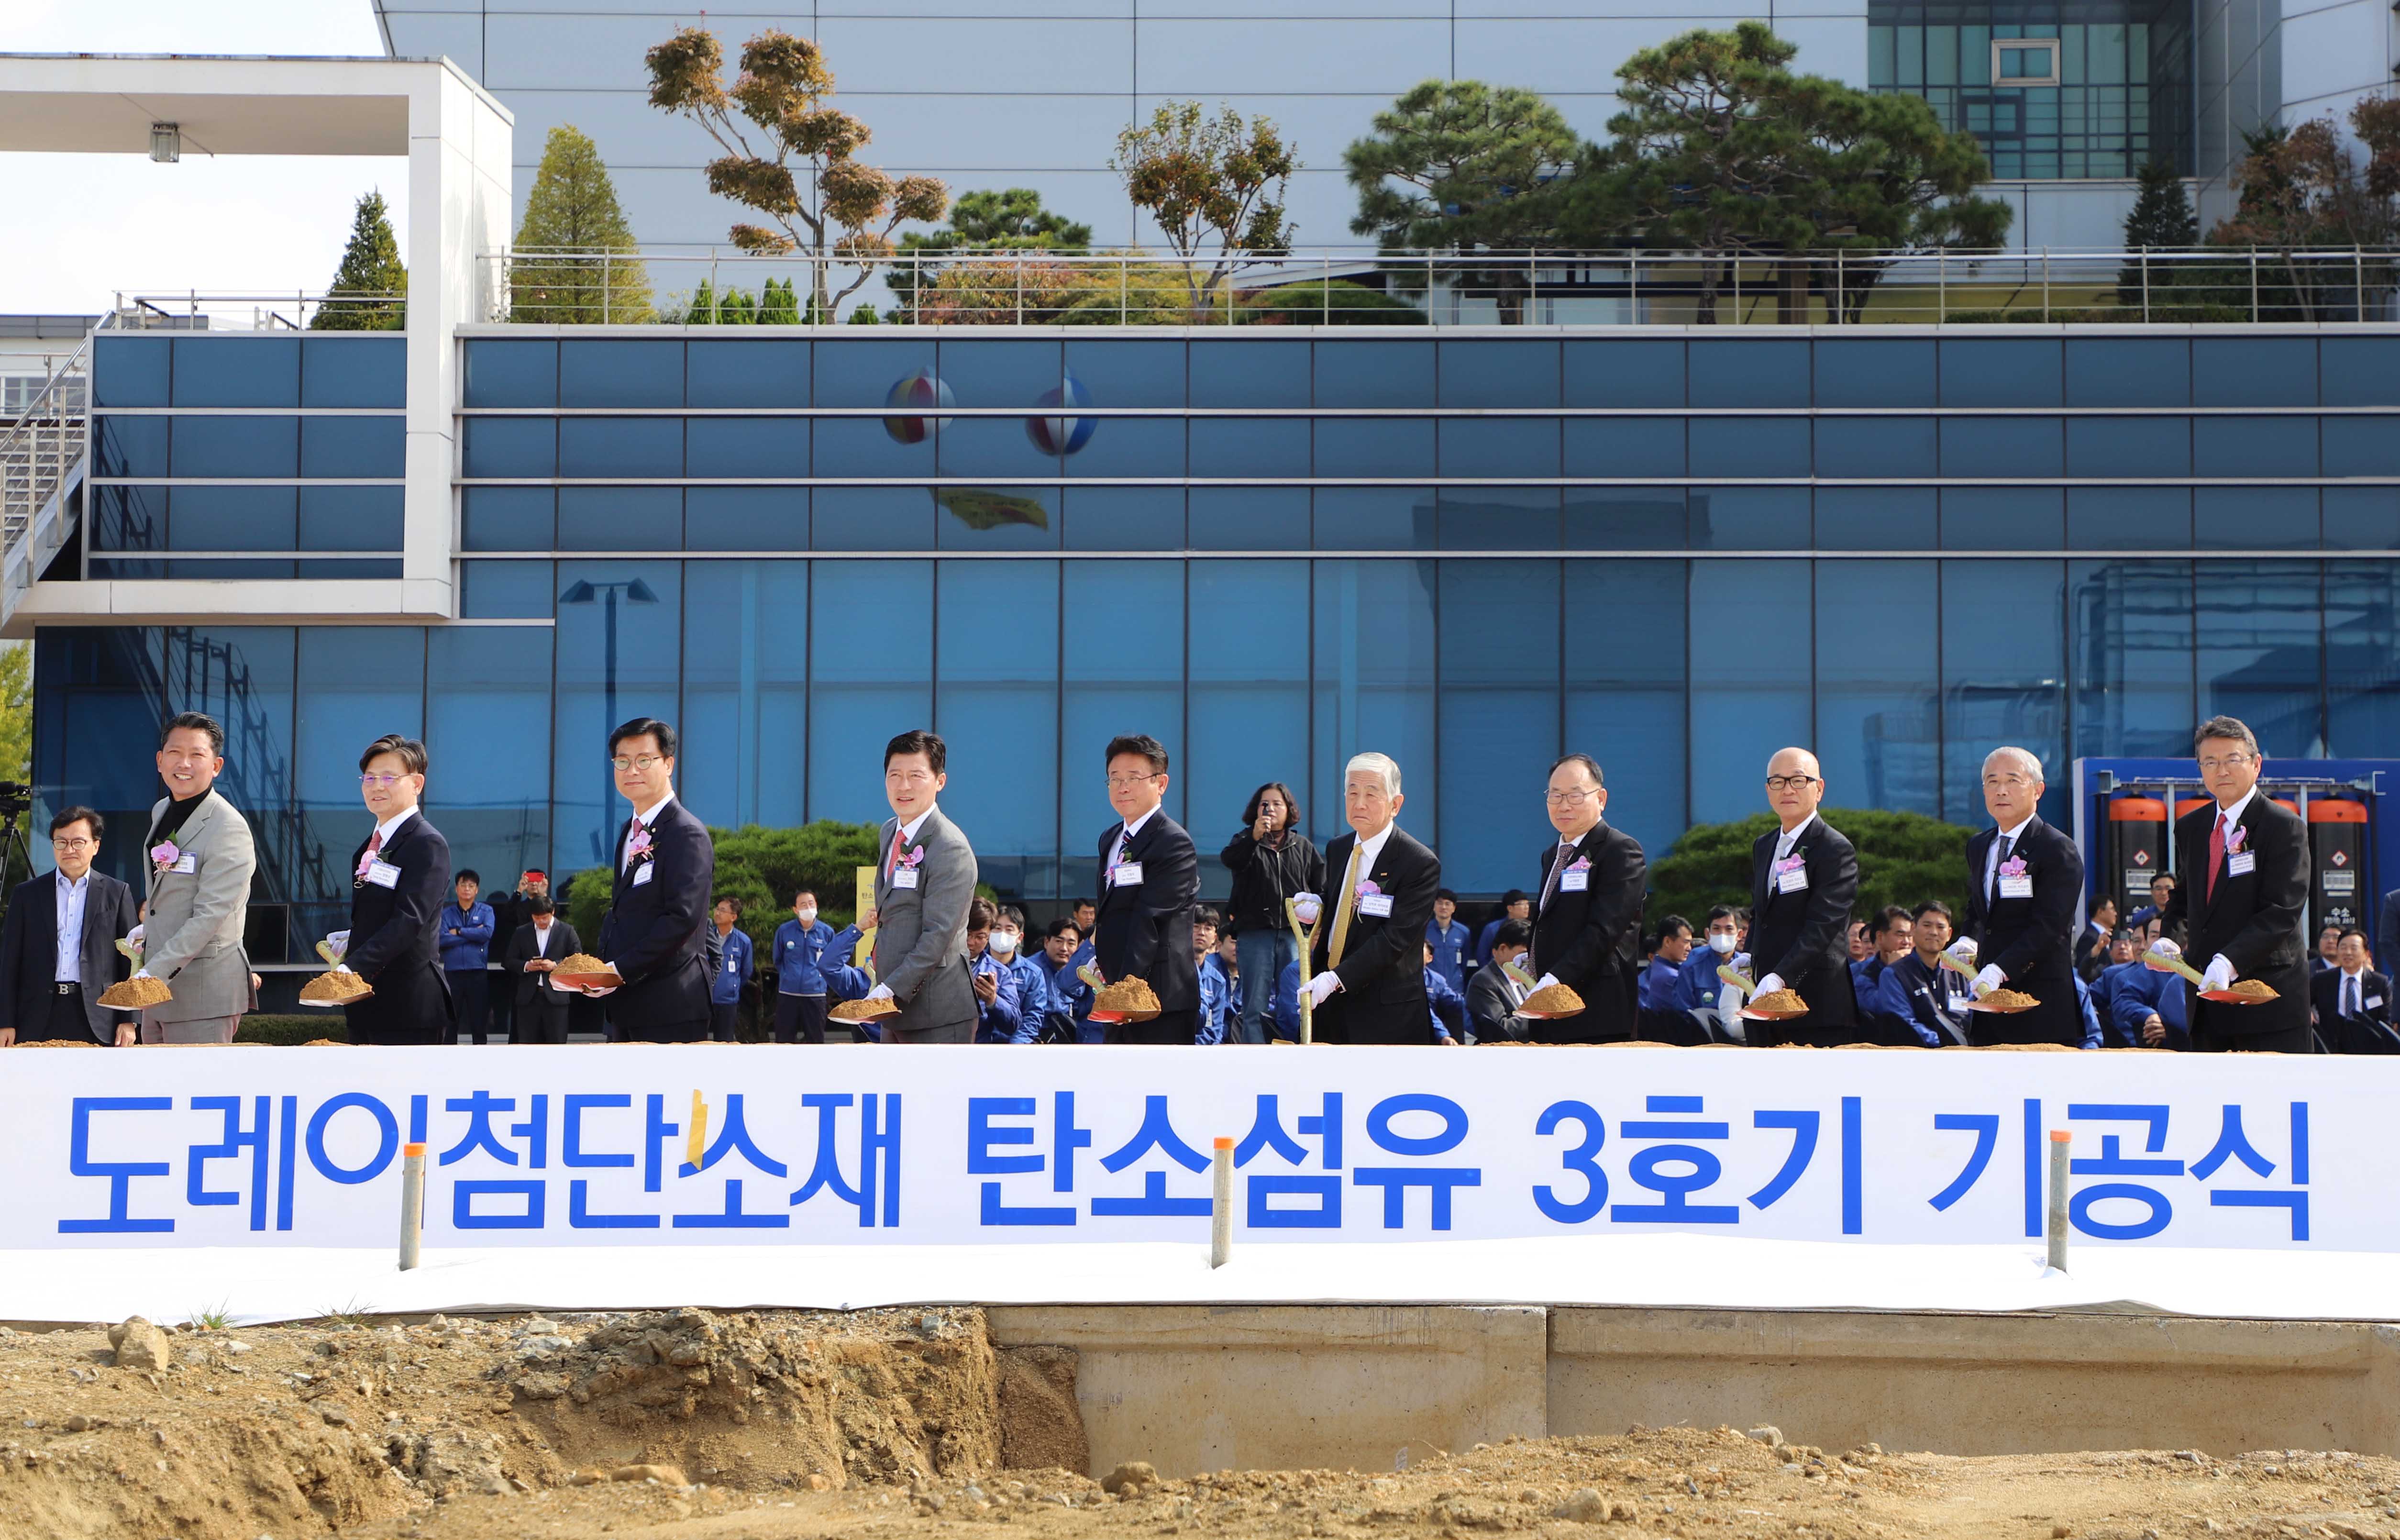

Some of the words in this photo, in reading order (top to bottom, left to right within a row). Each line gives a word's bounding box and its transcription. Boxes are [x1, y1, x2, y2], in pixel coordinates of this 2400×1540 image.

[58, 984, 68, 995] B
[58, 1091, 902, 1233] 도레이첨단소재
[967, 1091, 1482, 1230] 탄소섬유
[1532, 1096, 1862, 1234] 3호기
[1927, 1098, 2310, 1241] 기공식
